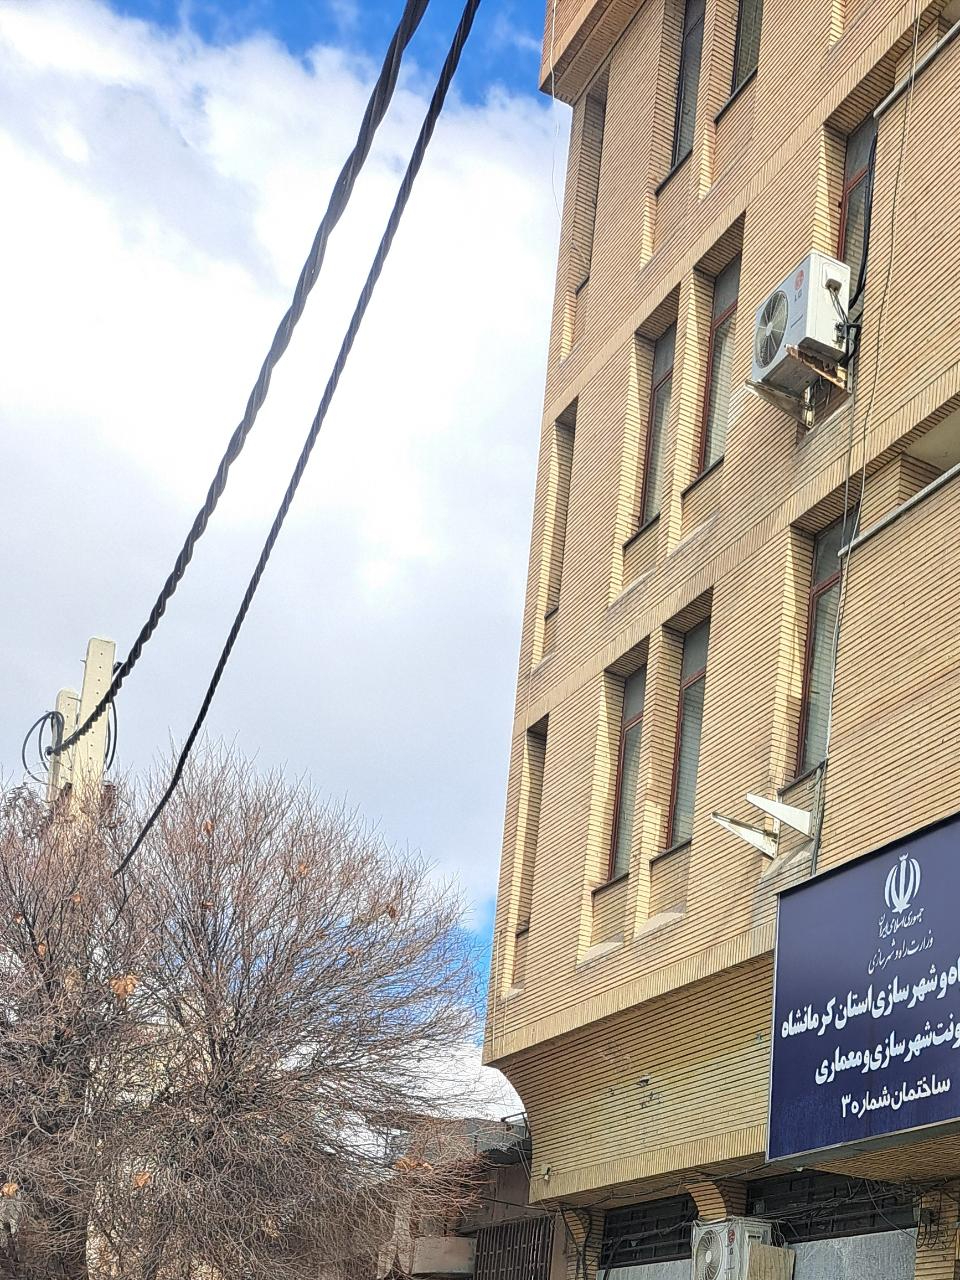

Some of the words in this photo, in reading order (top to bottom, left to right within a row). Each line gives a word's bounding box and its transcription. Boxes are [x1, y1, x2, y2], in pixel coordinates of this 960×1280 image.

[907, 929, 934, 956] وزارت
[937, 971, 948, 999] و
[781, 996, 836, 1038] کرمانشاه
[834, 984, 873, 1030] استان
[814, 1046, 863, 1085] معماری
[861, 1049, 870, 1074] و
[841, 1093, 852, 1118] ۳
[850, 1085, 892, 1118] شماره
[892, 1073, 951, 1111] ساختمان
